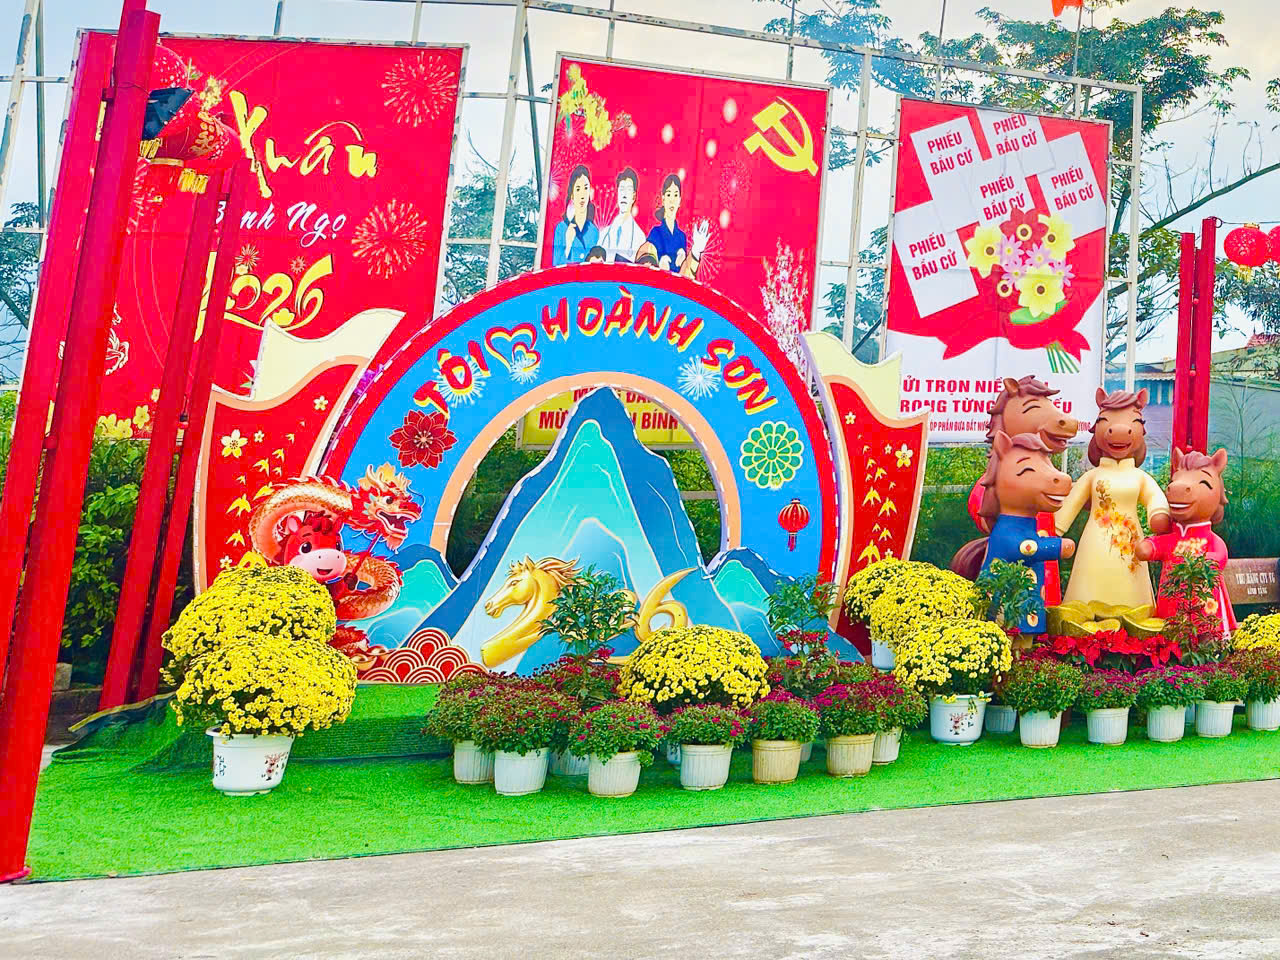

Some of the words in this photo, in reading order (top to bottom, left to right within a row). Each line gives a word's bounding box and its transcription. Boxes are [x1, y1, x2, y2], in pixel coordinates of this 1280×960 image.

[993, 113, 1027, 136] PHIẾU
[229, 90, 378, 198] Xuân
[927, 129, 963, 154] PHIẾU
[1021, 128, 1037, 148] CỬ
[930, 154, 955, 176] BẦU
[956, 146, 973, 166] CỬ
[979, 174, 1015, 199] PHIẾU
[1051, 165, 1085, 190] PHIẾU
[983, 200, 1008, 221] BẦU
[1009, 191, 1026, 212] CỬ
[1054, 190, 1078, 211] BẦU
[1079, 182, 1096, 203] CỬ
[286, 201, 347, 248] Ngọ
[908, 232, 946, 258] PHIẾU
[911, 258, 938, 280] BẦU
[939, 249, 957, 270] CỬ
[413, 339, 491, 419] TÔI
[540, 285, 704, 352] HOÀNH
[701, 338, 778, 415] SƠN
[902, 375, 920, 393] ỬI
[926, 379, 970, 395] TRỌN
[975, 376, 1003, 393] NIỀ
[641, 409, 679, 429] BÍNH
